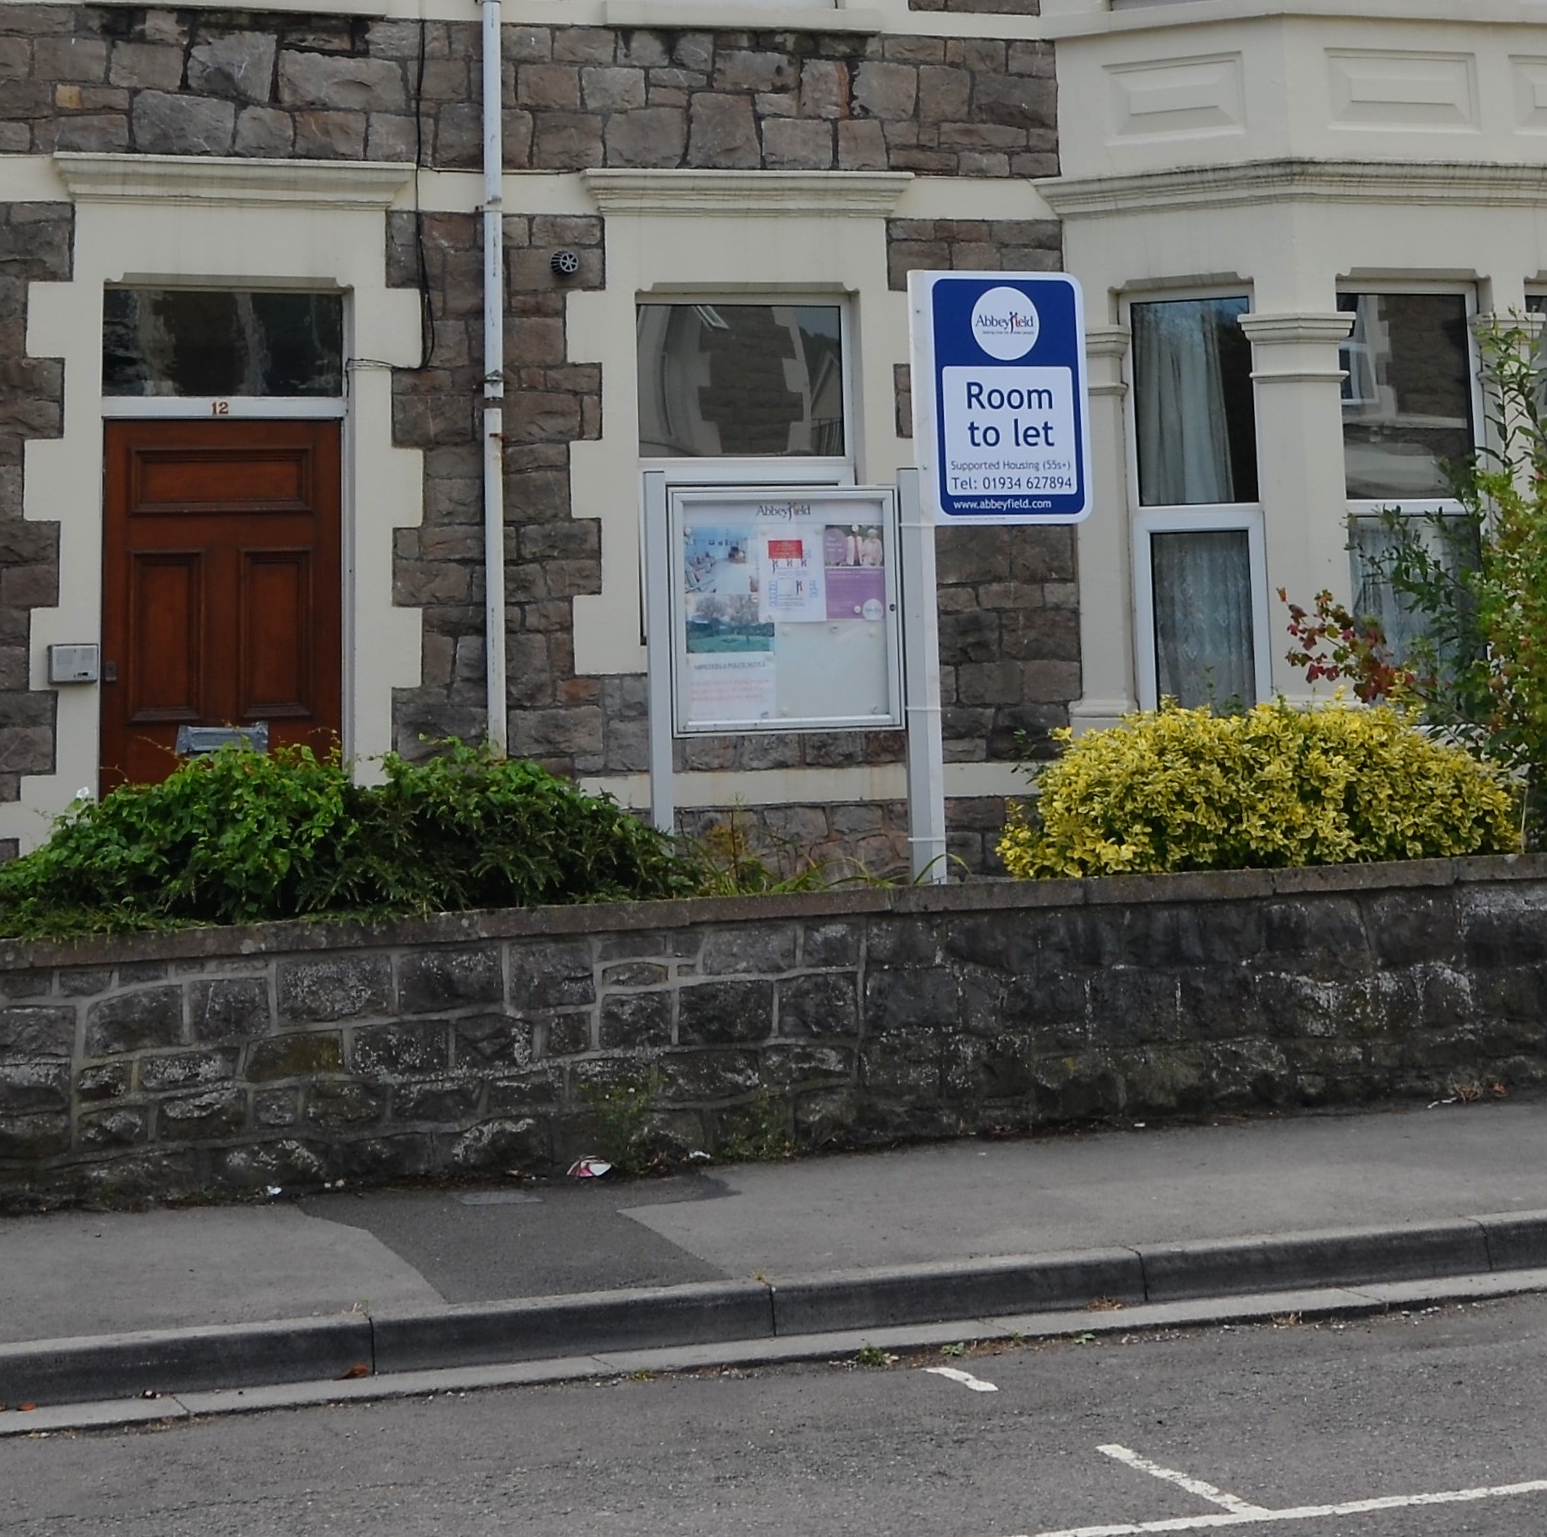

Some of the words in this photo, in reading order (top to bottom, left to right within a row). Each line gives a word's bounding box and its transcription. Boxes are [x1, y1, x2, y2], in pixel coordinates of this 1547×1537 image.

[975, 311, 1034, 333] Abbeyfield
[965, 381, 1053, 410] Room
[211, 402, 229, 415] 12
[968, 421, 1000, 447] to
[1013, 418, 1055, 447] let
[951, 460, 1000, 472] Supported
[1002, 460, 1040, 471] Housing
[1042, 459, 1071, 471] (55s+)
[951, 477, 977, 489] Tel:
[982, 476, 1022, 489] 01934
[1026, 476, 1072, 489] 627894
[756, 502, 811, 521] Abbeyfield
[953, 498, 1052, 511] www.abbeyfield.com
